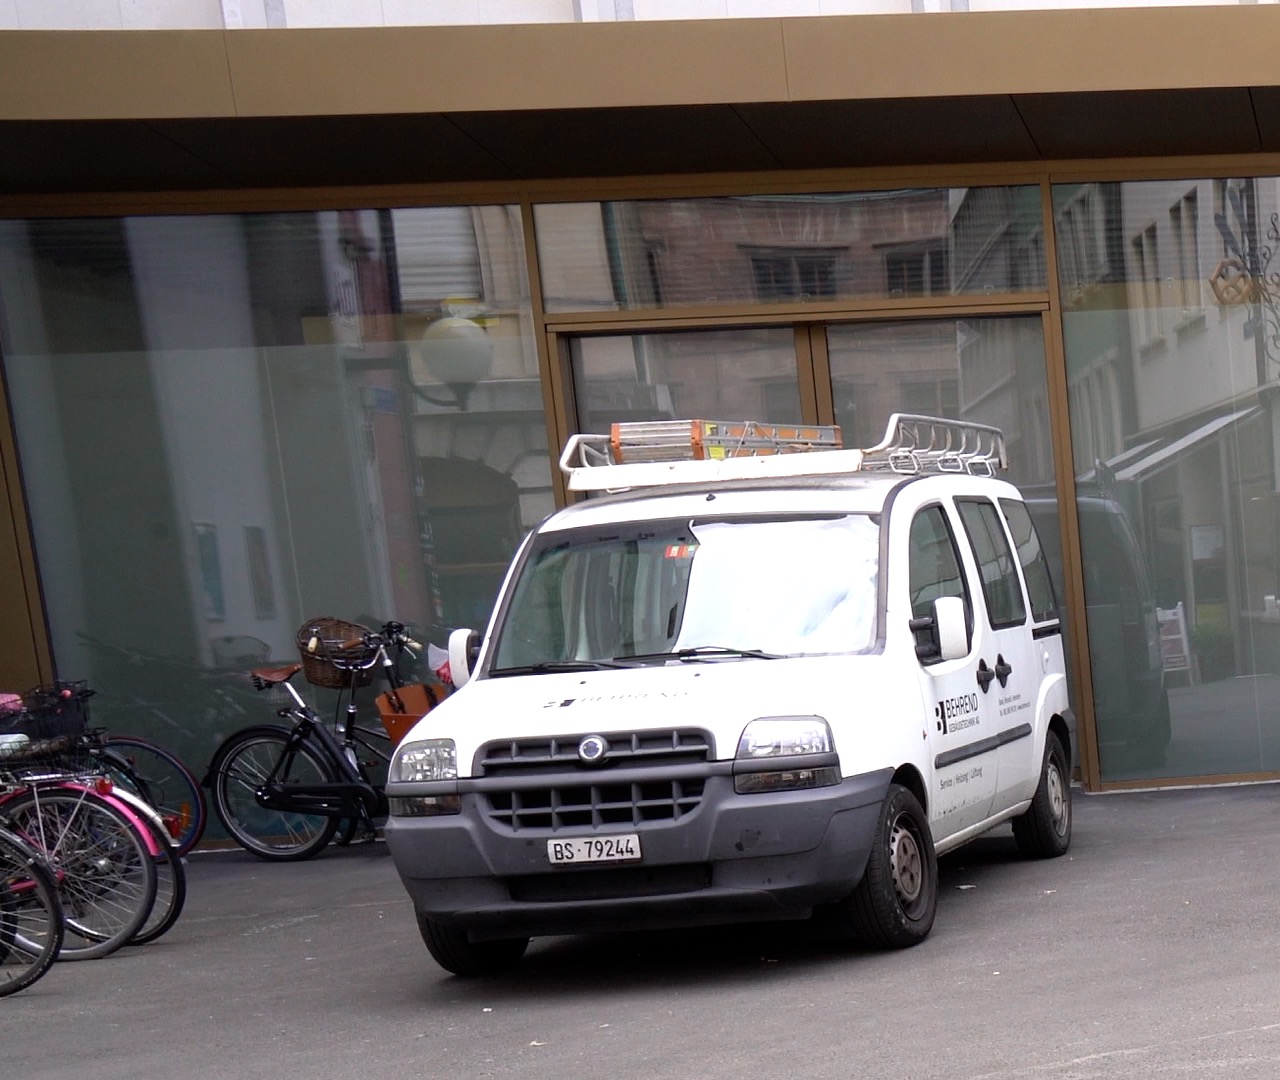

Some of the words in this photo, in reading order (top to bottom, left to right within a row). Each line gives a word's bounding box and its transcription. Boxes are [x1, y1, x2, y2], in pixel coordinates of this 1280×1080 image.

[945, 692, 979, 719] BEHREND
[553, 842, 575, 860] BS
[584, 839, 634, 858] 79244
